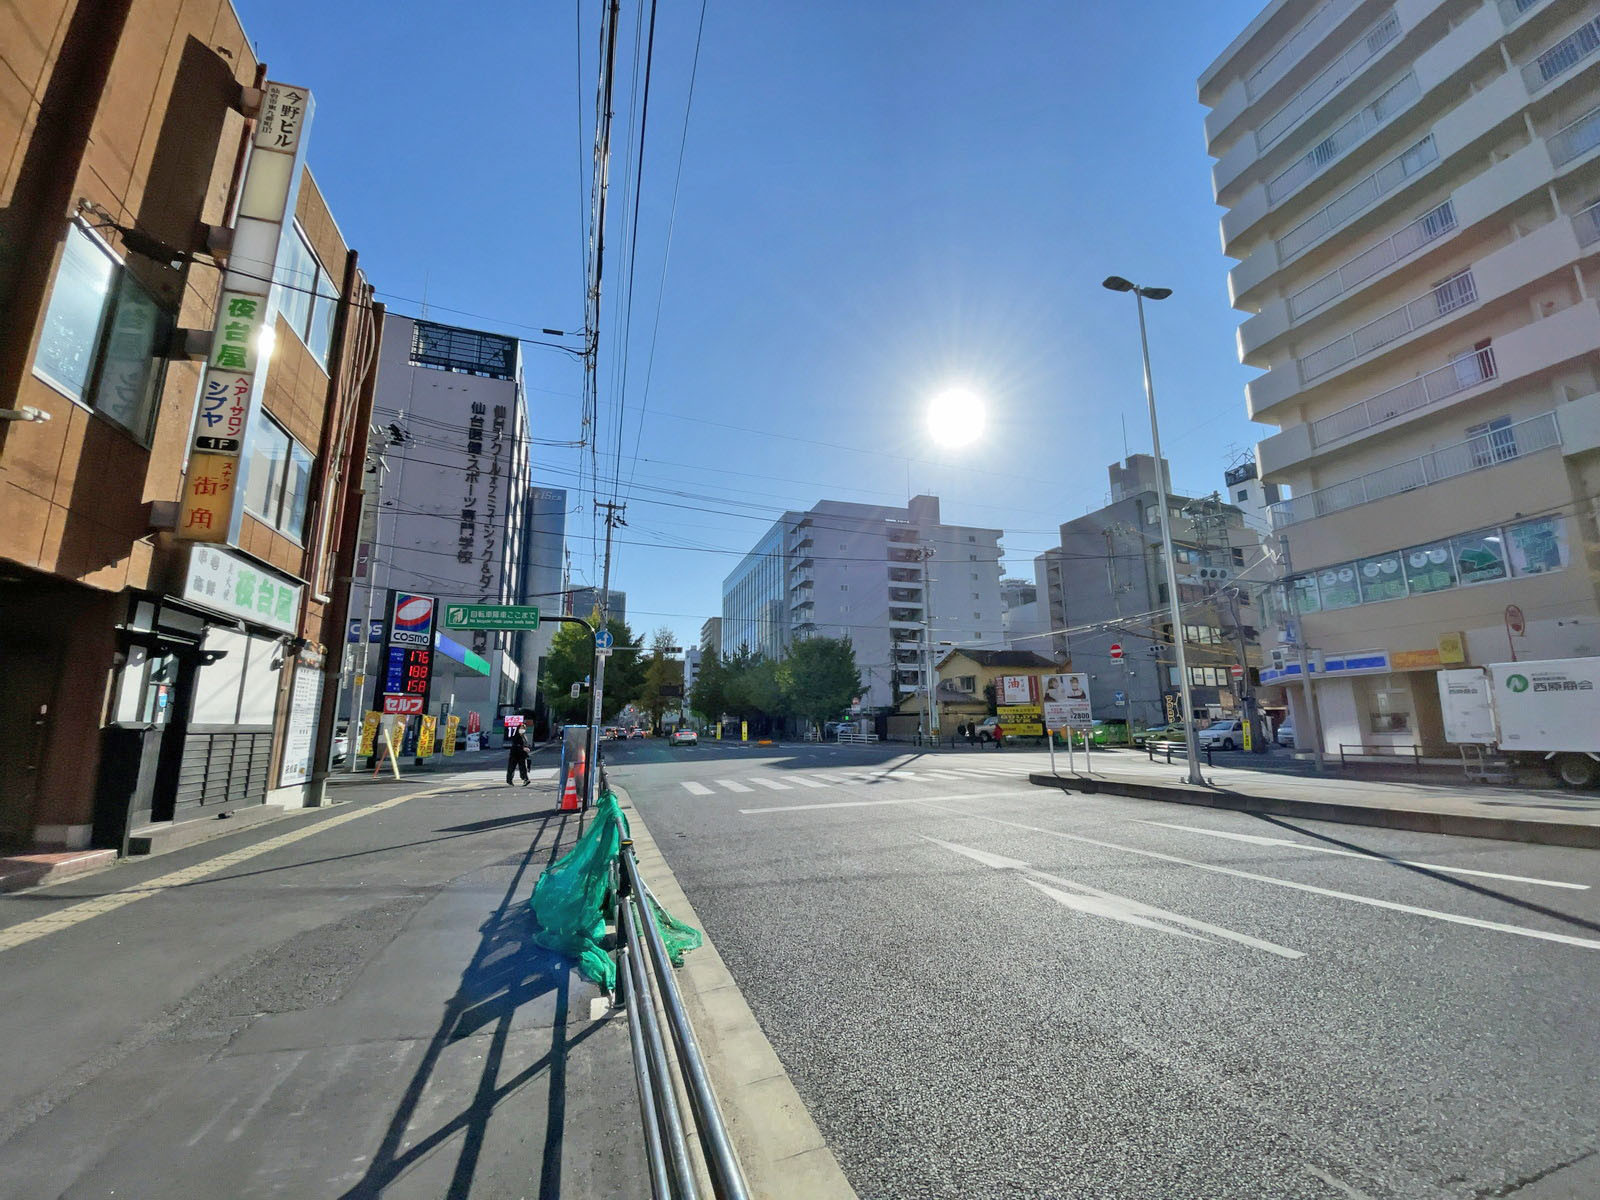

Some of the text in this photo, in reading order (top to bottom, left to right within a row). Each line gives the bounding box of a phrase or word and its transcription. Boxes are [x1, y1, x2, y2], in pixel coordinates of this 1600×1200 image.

[274, 91, 303, 147] 今野ビル
[226, 377, 249, 437] ヘアーサロン
[207, 439, 230, 449] 1F
[218, 462, 233, 491] スナック
[187, 476, 219, 530] 街角
[393, 632, 428, 644] COSMO
[410, 650, 429, 664] 176
[408, 665, 428, 678] 188
[407, 680, 427, 693] 158
[1008, 678, 1020, 689] 油
[1534, 680, 1593, 693] 西原商会
[385, 697, 424, 712] セルフ
